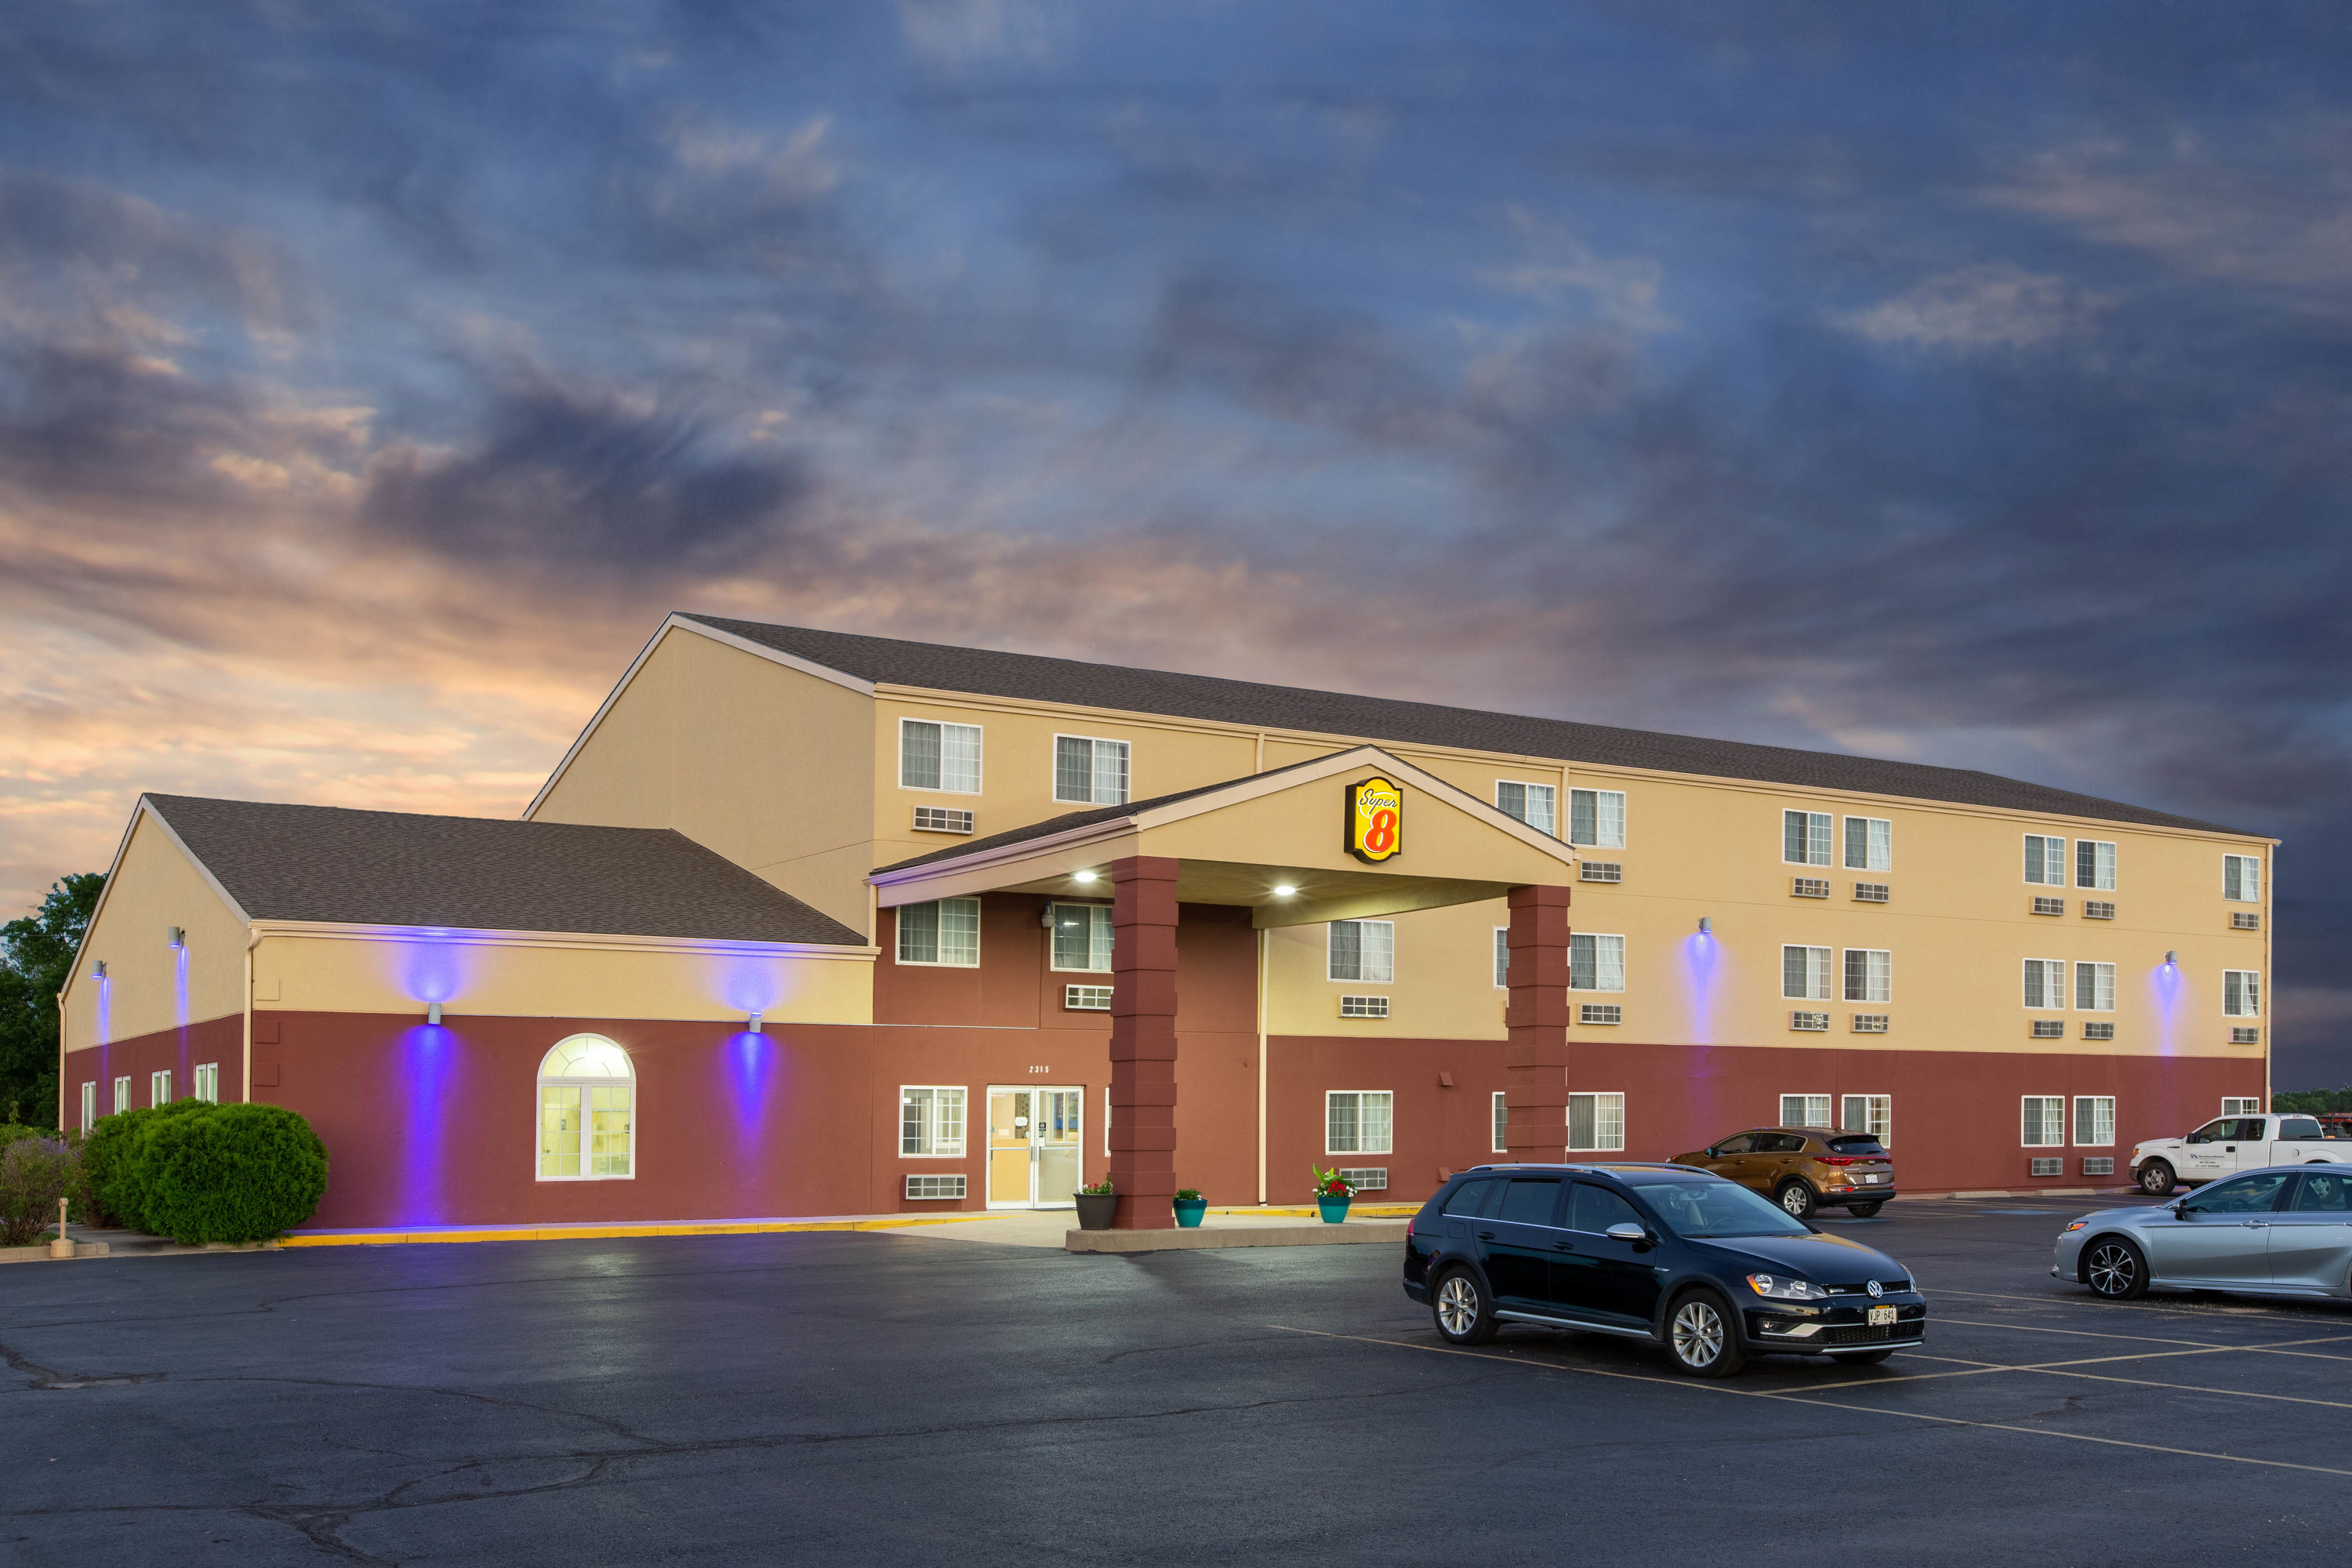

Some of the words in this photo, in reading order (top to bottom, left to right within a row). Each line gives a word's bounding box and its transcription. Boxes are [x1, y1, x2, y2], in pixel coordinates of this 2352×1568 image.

[1358, 789, 1397, 815] Super
[1363, 809, 1397, 853] 8
[1870, 1310, 1880, 1321] VJP
[1884, 1309, 1894, 1320] 641
